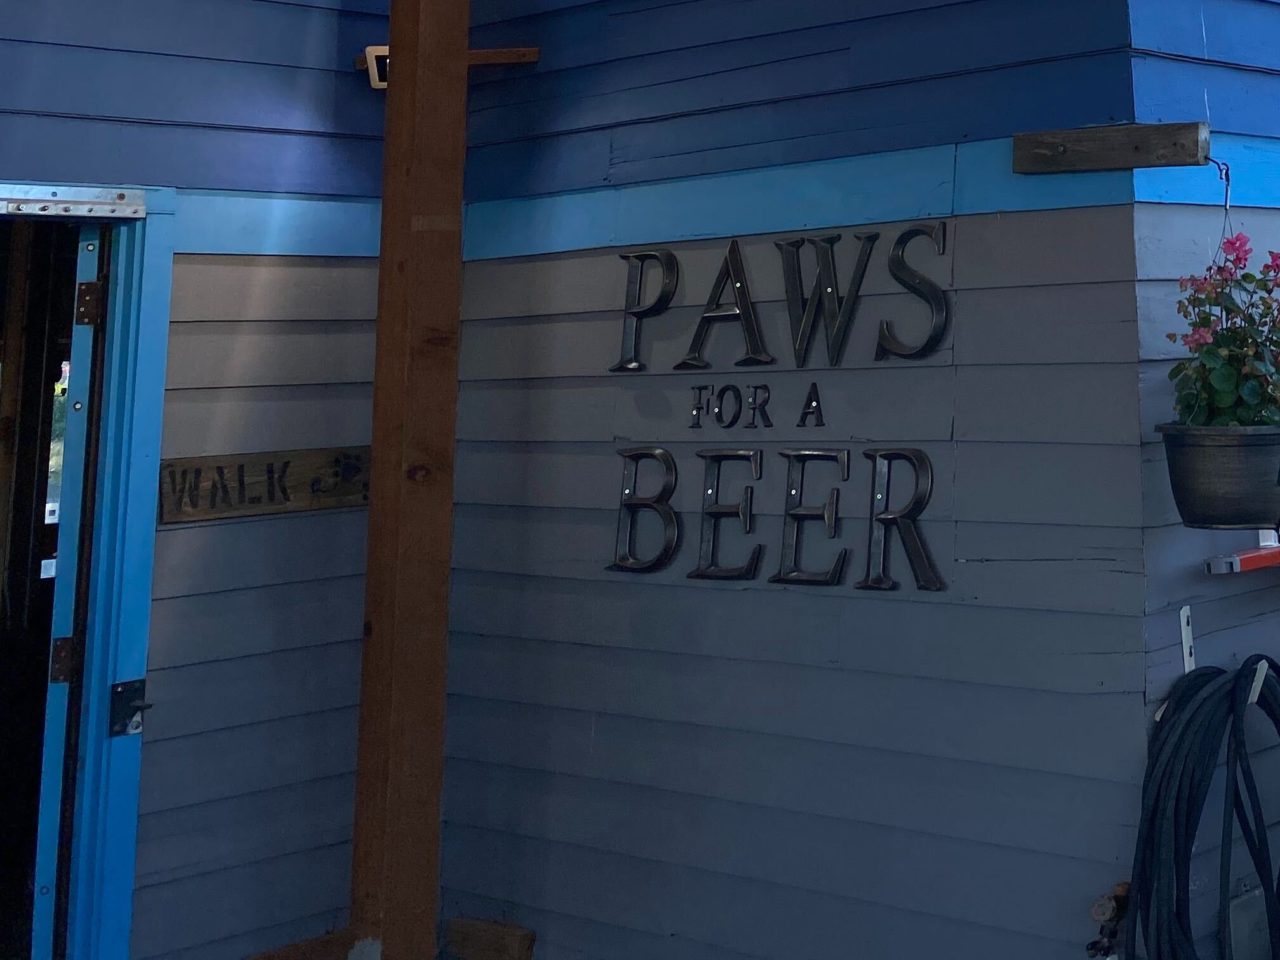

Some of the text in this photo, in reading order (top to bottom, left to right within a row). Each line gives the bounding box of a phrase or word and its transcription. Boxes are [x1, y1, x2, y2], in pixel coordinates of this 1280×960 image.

[609, 221, 949, 373] PAWS
[688, 382, 826, 429] FOR A
[167, 459, 292, 512] WALK
[604, 446, 947, 592] BEER
